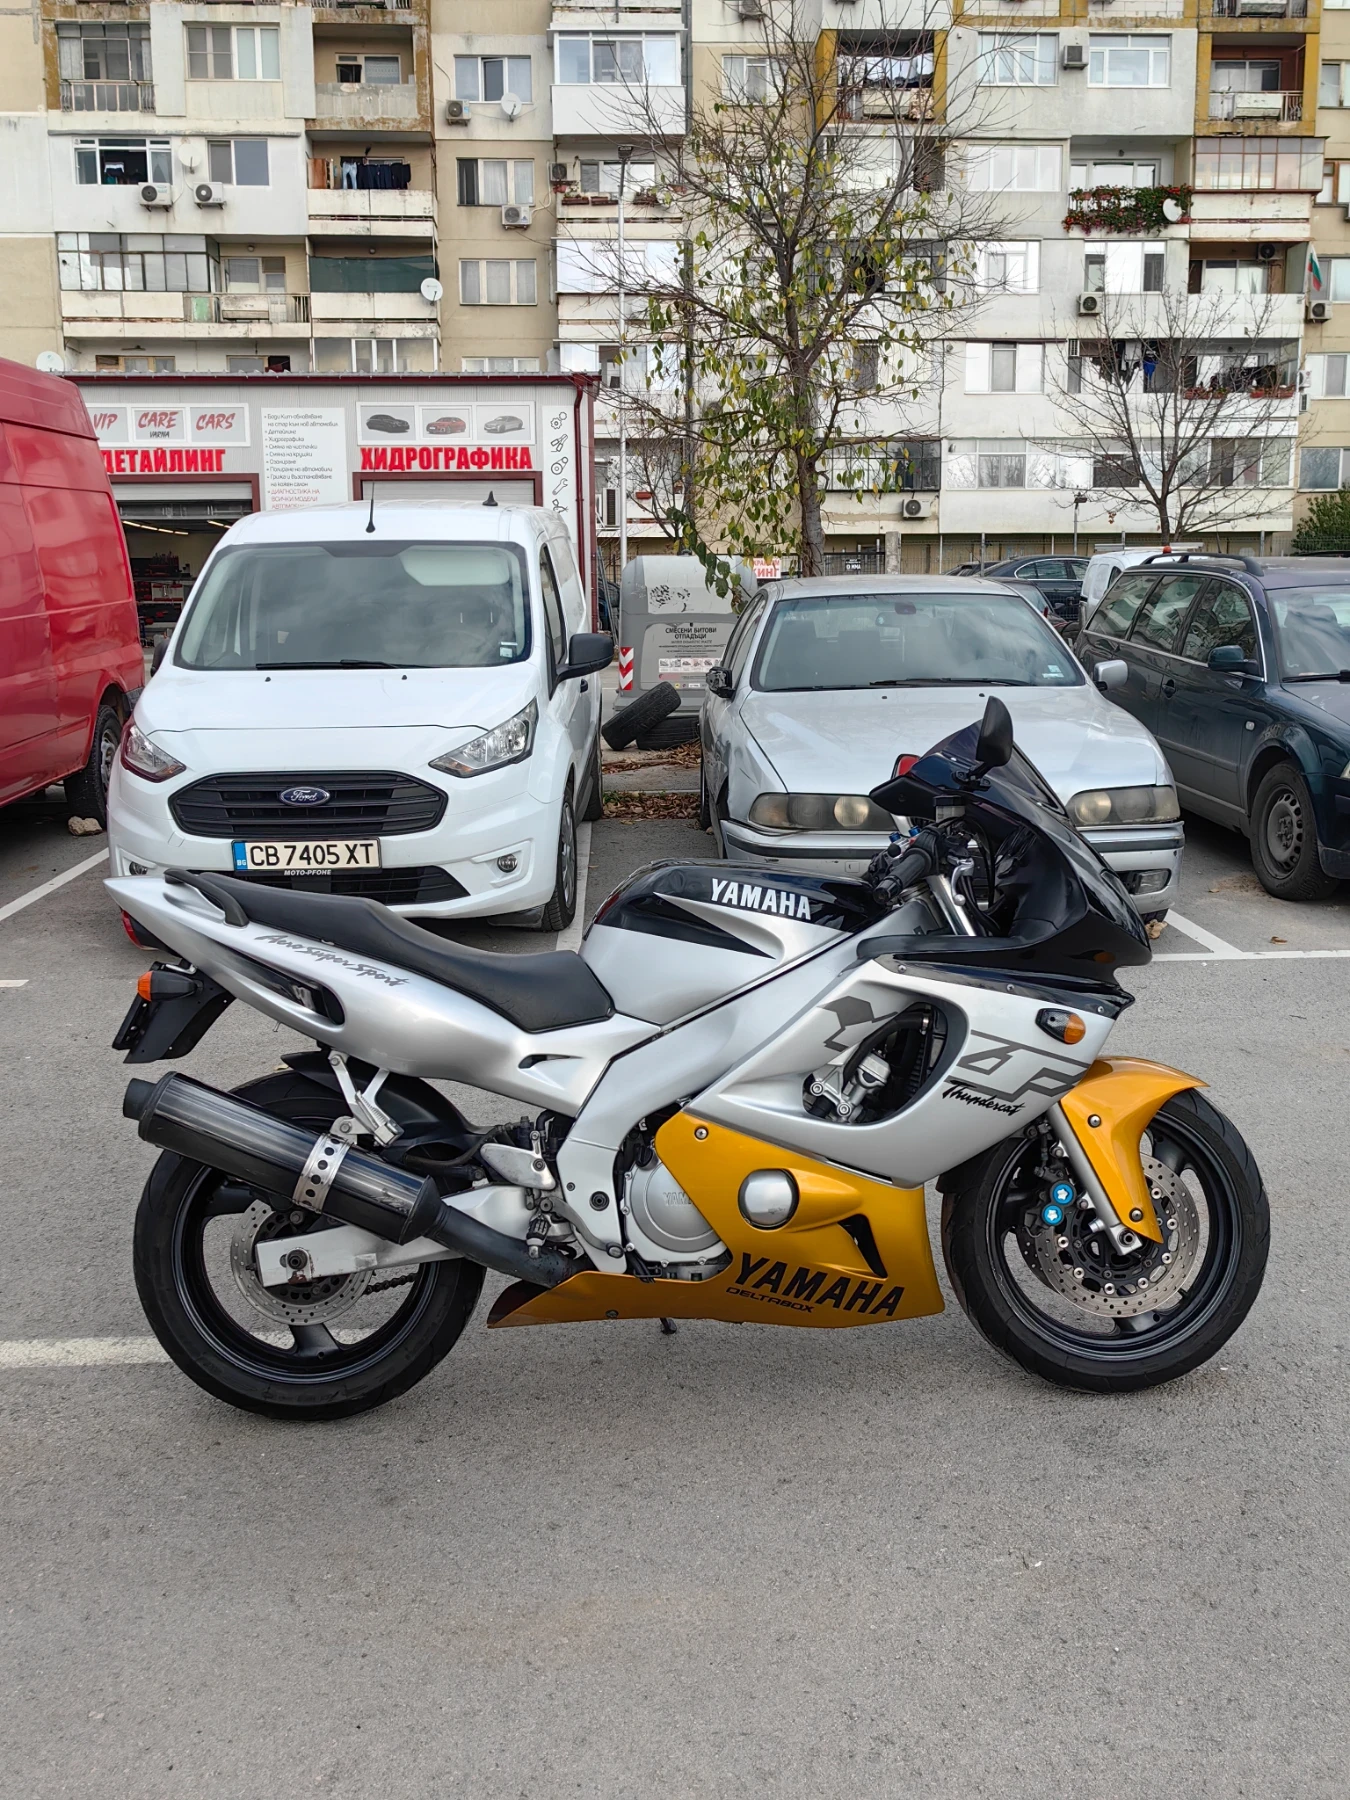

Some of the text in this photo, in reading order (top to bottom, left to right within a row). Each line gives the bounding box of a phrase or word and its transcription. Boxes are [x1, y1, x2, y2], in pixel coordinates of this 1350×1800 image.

[93, 411, 236, 431] VIP CARE CARS
[100, 447, 226, 474] ДЕТАЙЛИНГ
[360, 446, 533, 472] ХИДРОГРАФИКА
[290, 790, 318, 801] Ford
[284, 844, 340, 866] 7405
[711, 878, 811, 920] YAMAHA
[352, 963, 411, 987] Sport
[941, 1080, 1027, 1116] Thundercat
[733, 1252, 905, 1317] YAMAHA
[725, 1286, 816, 1314] DELTABOX
